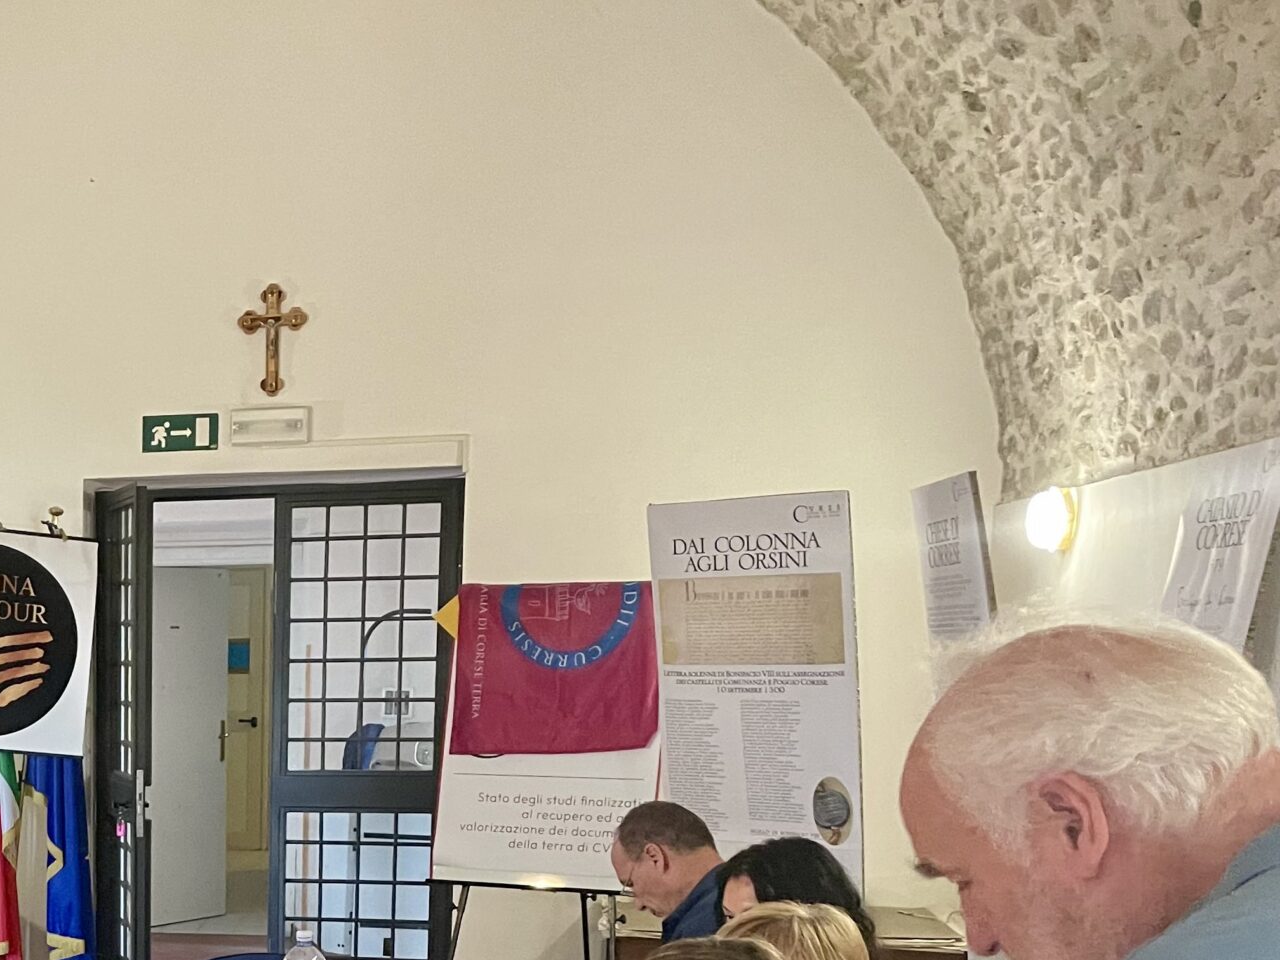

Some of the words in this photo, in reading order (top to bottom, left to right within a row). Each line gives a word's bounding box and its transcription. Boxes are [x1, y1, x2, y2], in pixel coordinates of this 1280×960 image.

[672, 537, 705, 555] DAI
[715, 531, 822, 554] COLONNA
[685, 554, 729, 573] AGLI
[738, 550, 809, 570] ORSINI
[616, 582, 638, 626] DII
[478, 617, 488, 630] DI
[509, 620, 602, 668] CURRESIS
[474, 634, 487, 679] CORESE
[471, 681, 483, 719] TERRA
[478, 792, 510, 804] Stato
[513, 793, 543, 807] degli
[546, 794, 576, 806] studi
[521, 810, 533, 819] al
[536, 811, 593, 822] recupero
[596, 812, 612, 823] ed
[460, 821, 545, 835] valorizzazione
[548, 825, 568, 836] dei
[508, 839, 538, 850] della
[542, 840, 573, 851] terra
[577, 841, 588, 852] di
